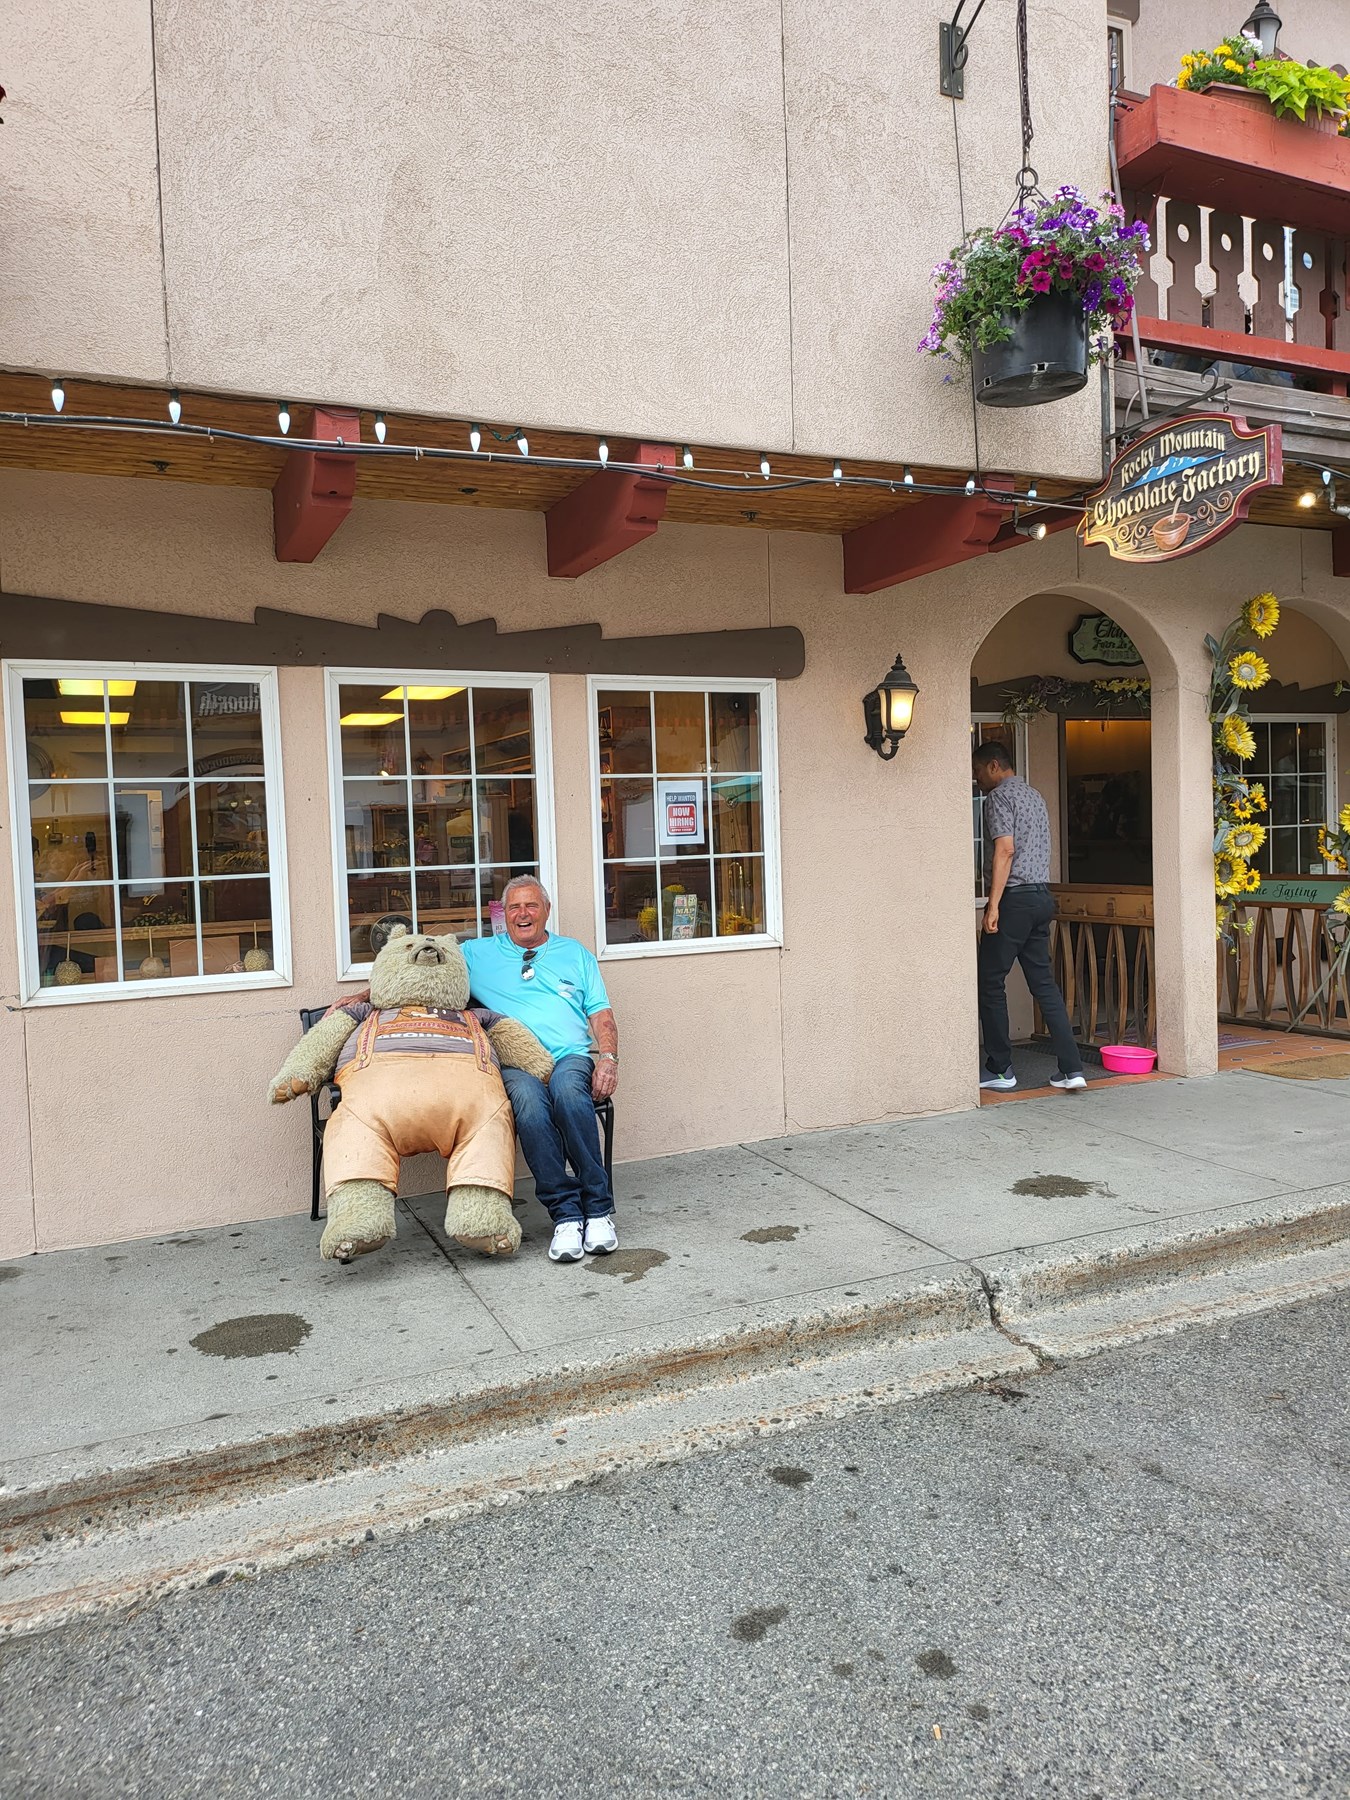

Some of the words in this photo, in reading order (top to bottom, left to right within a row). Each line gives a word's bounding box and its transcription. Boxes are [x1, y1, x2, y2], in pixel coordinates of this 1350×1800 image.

[1121, 445, 1155, 488] Rocky
[1160, 428, 1226, 456] Mountain
[1093, 480, 1178, 527] Chocolate
[1181, 450, 1260, 503] Factory
[678, 794, 696, 802] WANTED
[672, 807, 690, 817] NOW
[669, 817, 694, 827] HIRING
[1272, 882, 1317, 903] Tasting
[675, 907, 695, 915] MAP
